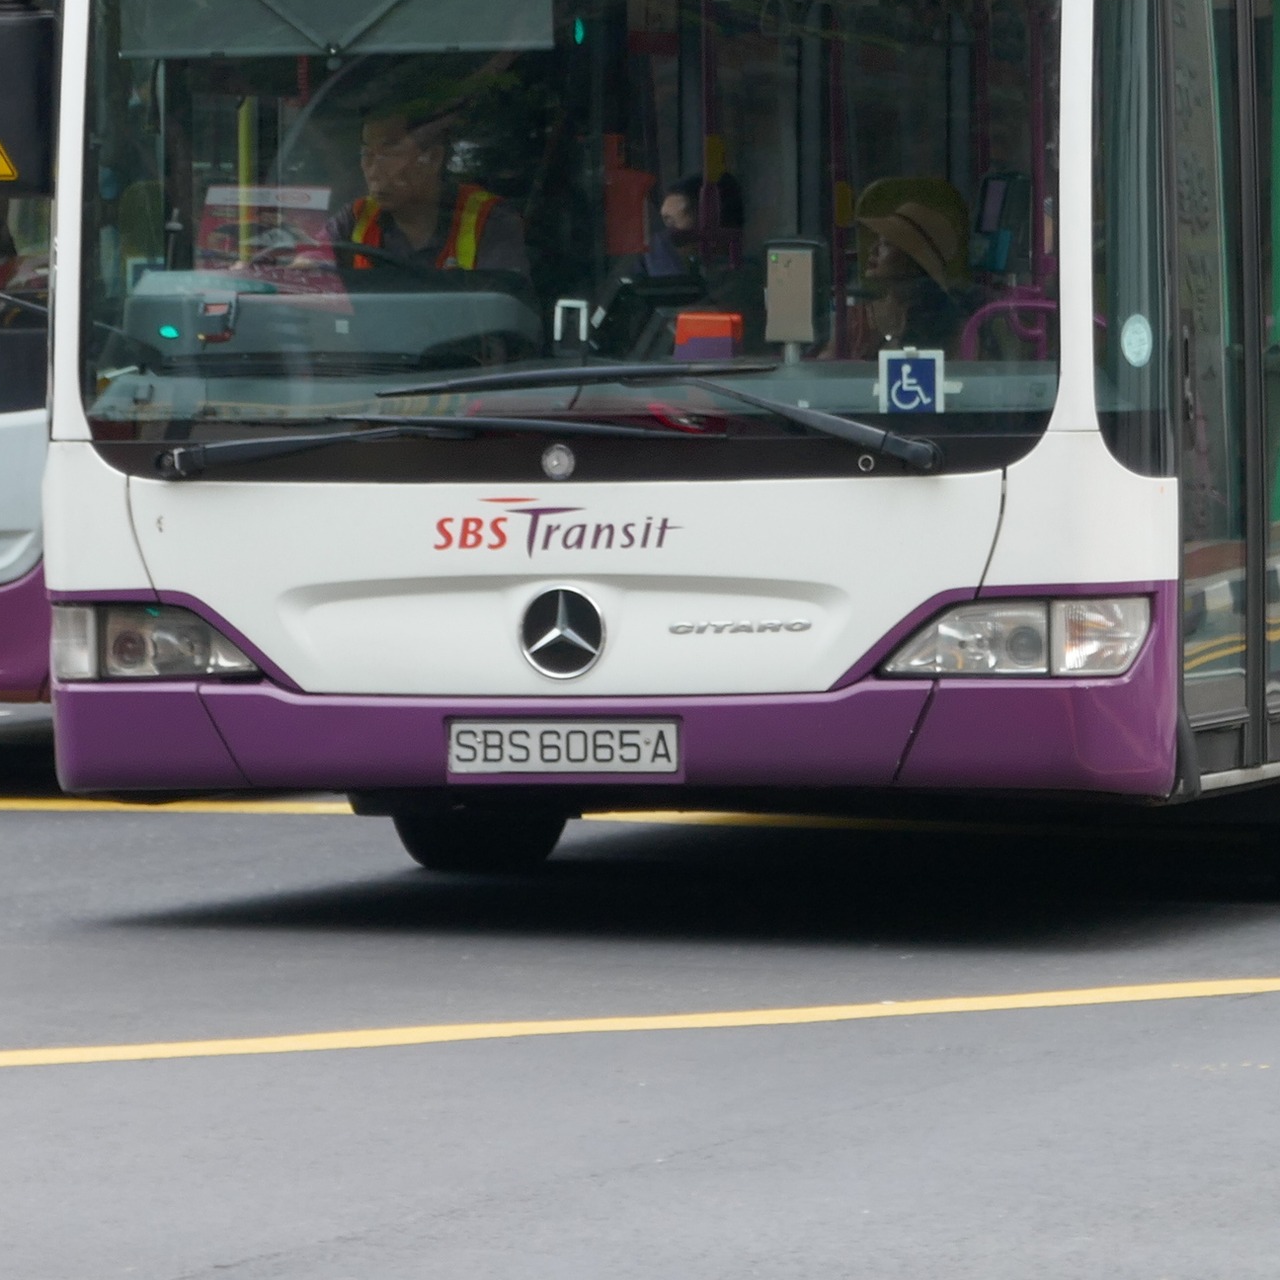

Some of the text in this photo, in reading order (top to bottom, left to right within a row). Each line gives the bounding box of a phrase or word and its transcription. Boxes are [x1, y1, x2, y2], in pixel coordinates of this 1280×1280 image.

[433, 506, 686, 560] SBS Transit
[668, 618, 813, 636] CITARO
[454, 728, 672, 764] SBS6065A
